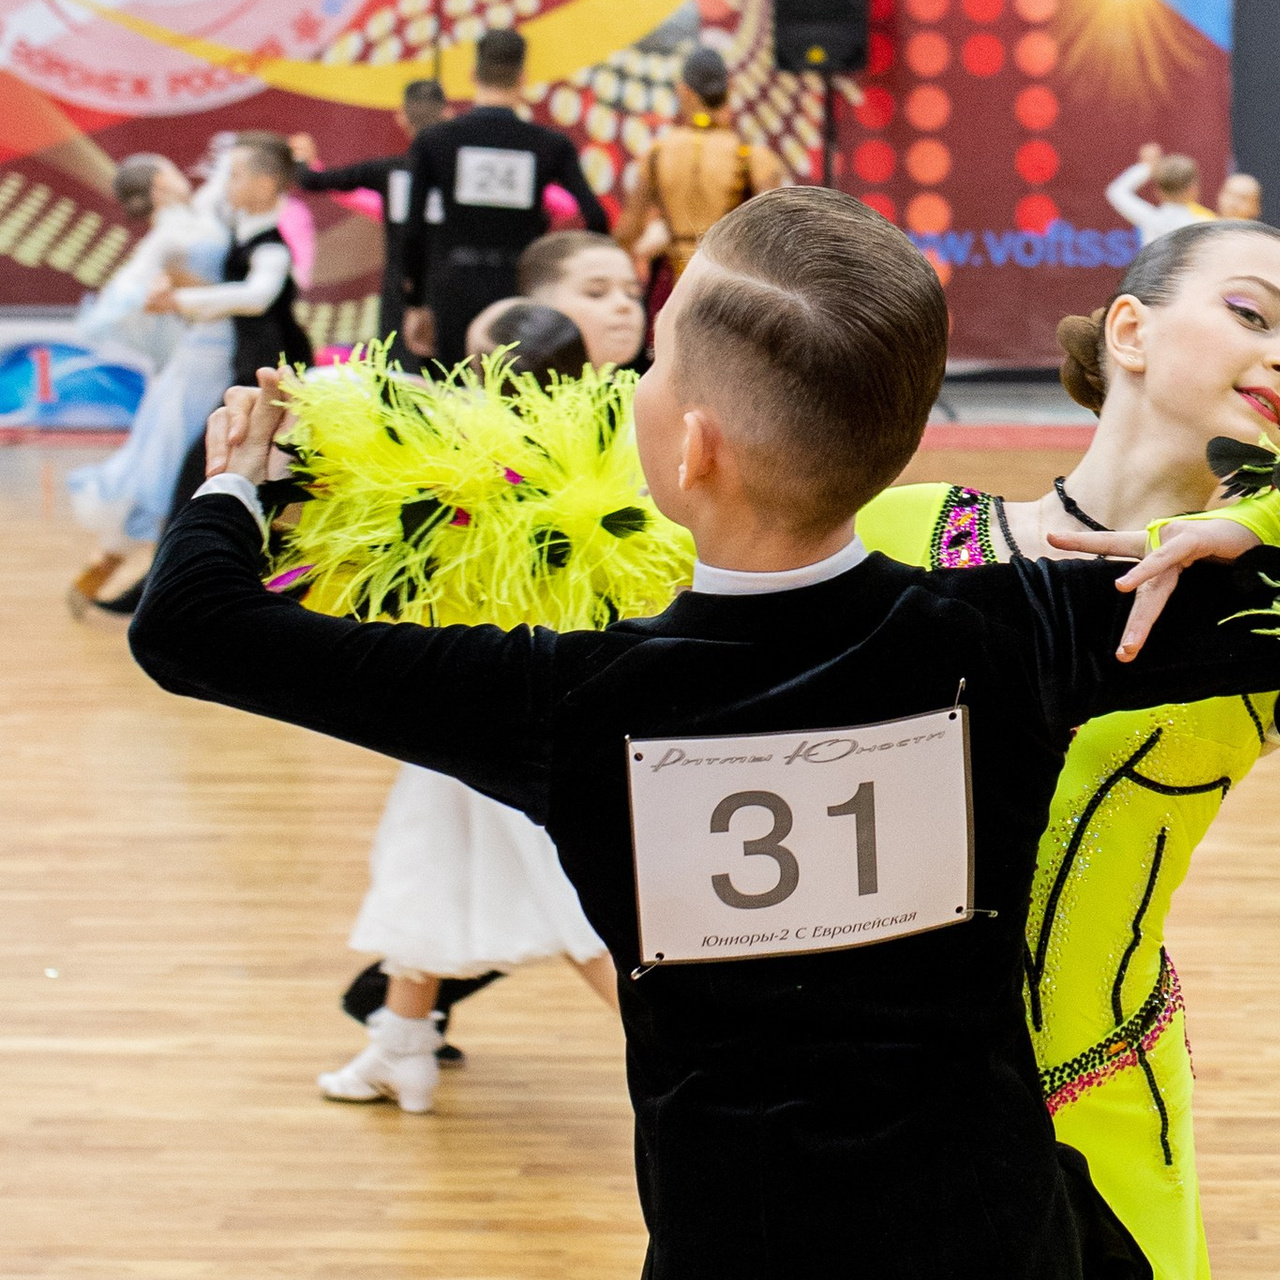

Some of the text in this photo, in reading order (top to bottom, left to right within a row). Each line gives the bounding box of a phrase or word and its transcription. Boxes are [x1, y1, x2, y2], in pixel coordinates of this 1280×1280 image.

[710, 781, 879, 910] 31
[701, 928, 789, 948] Юниоры-2
[812, 911, 917, 939] Европейская
